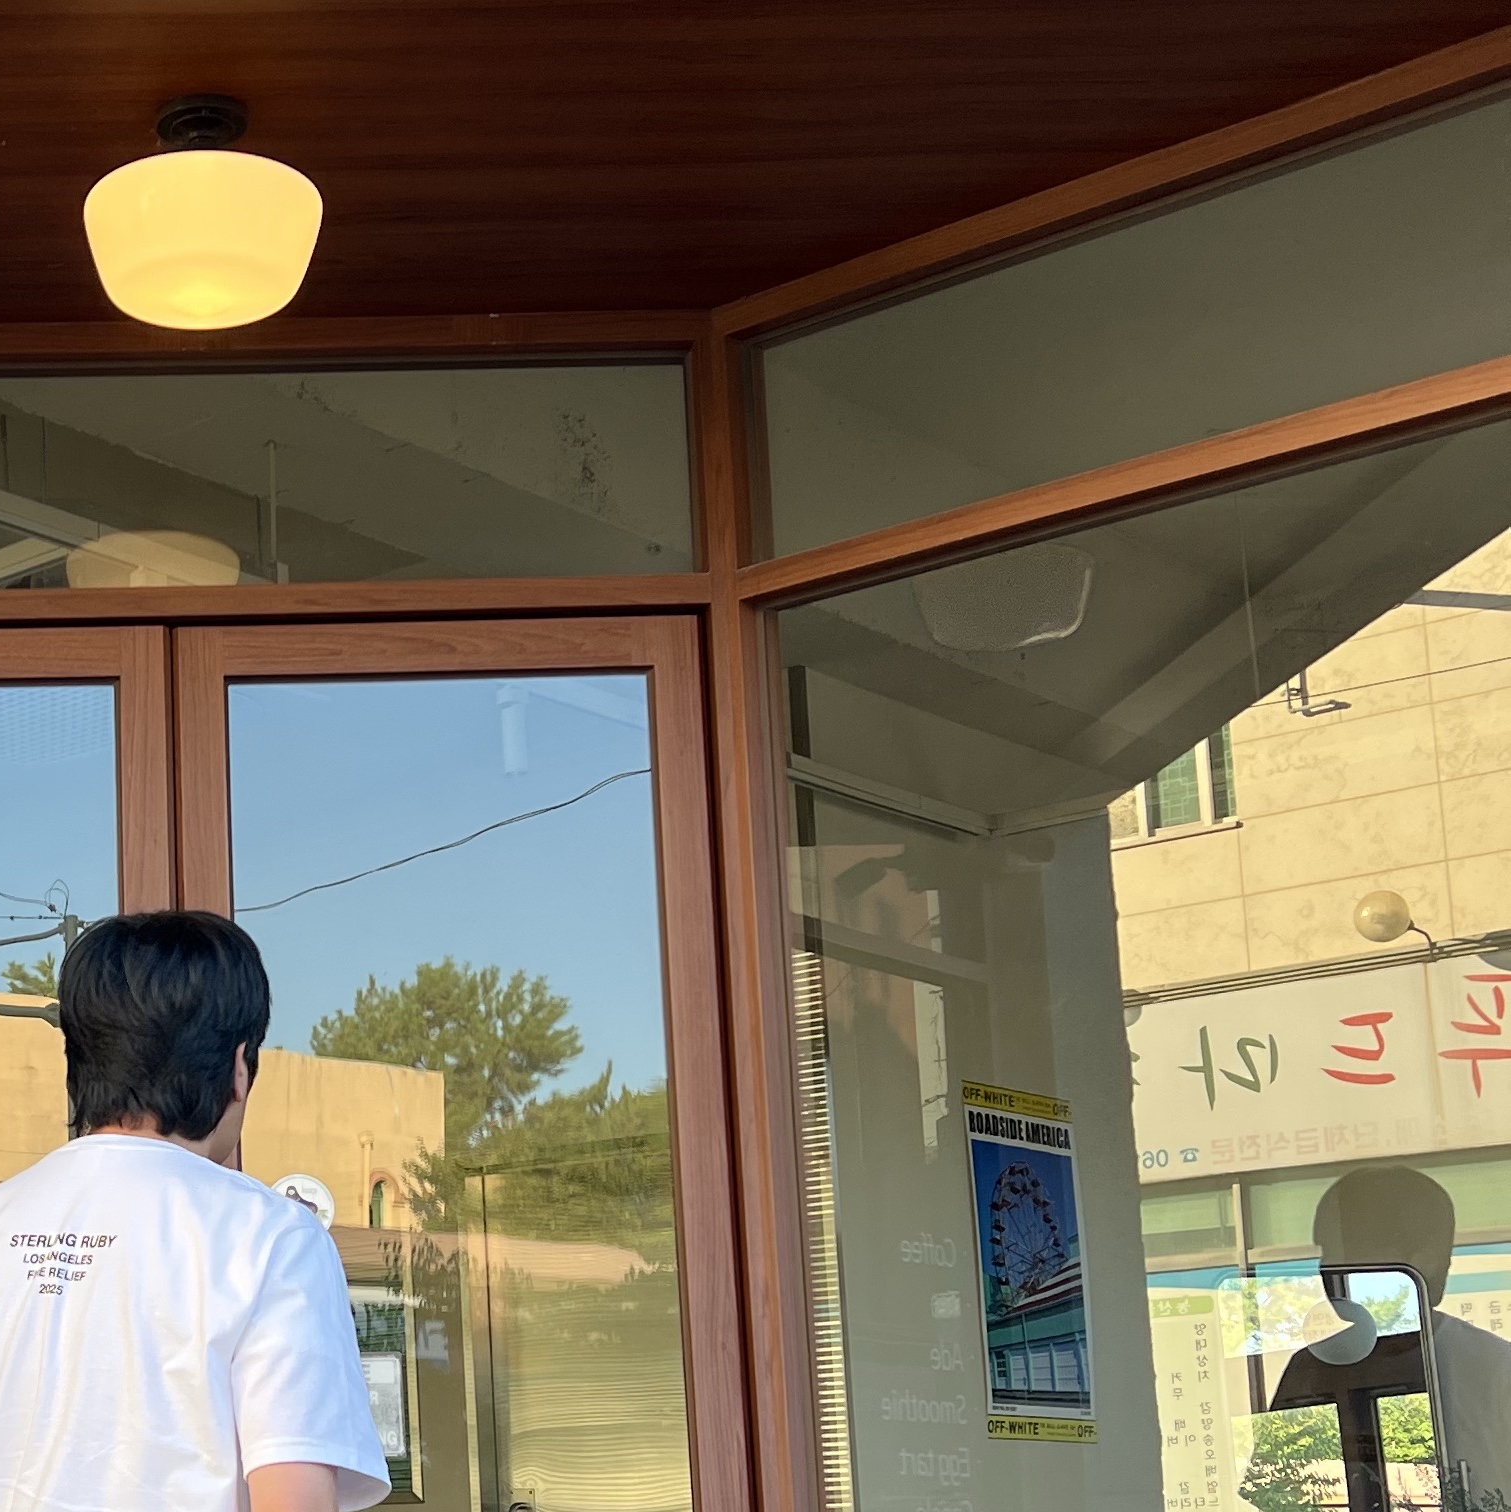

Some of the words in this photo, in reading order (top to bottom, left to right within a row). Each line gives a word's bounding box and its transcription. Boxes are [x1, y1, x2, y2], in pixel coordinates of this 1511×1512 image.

[962, 1086, 1016, 1108] OFF-WHITE
[968, 1110, 1025, 1141] ROADSIDE
[1025, 1121, 1072, 1151] AMERICA
[80, 1234, 118, 1249] RUBY
[23, 1253, 46, 1264] LOS
[48, 1266, 87, 1281] RELIEF
[38, 1283, 64, 1296] 2025
[987, 1419, 1040, 1436] OFF-WHITE
